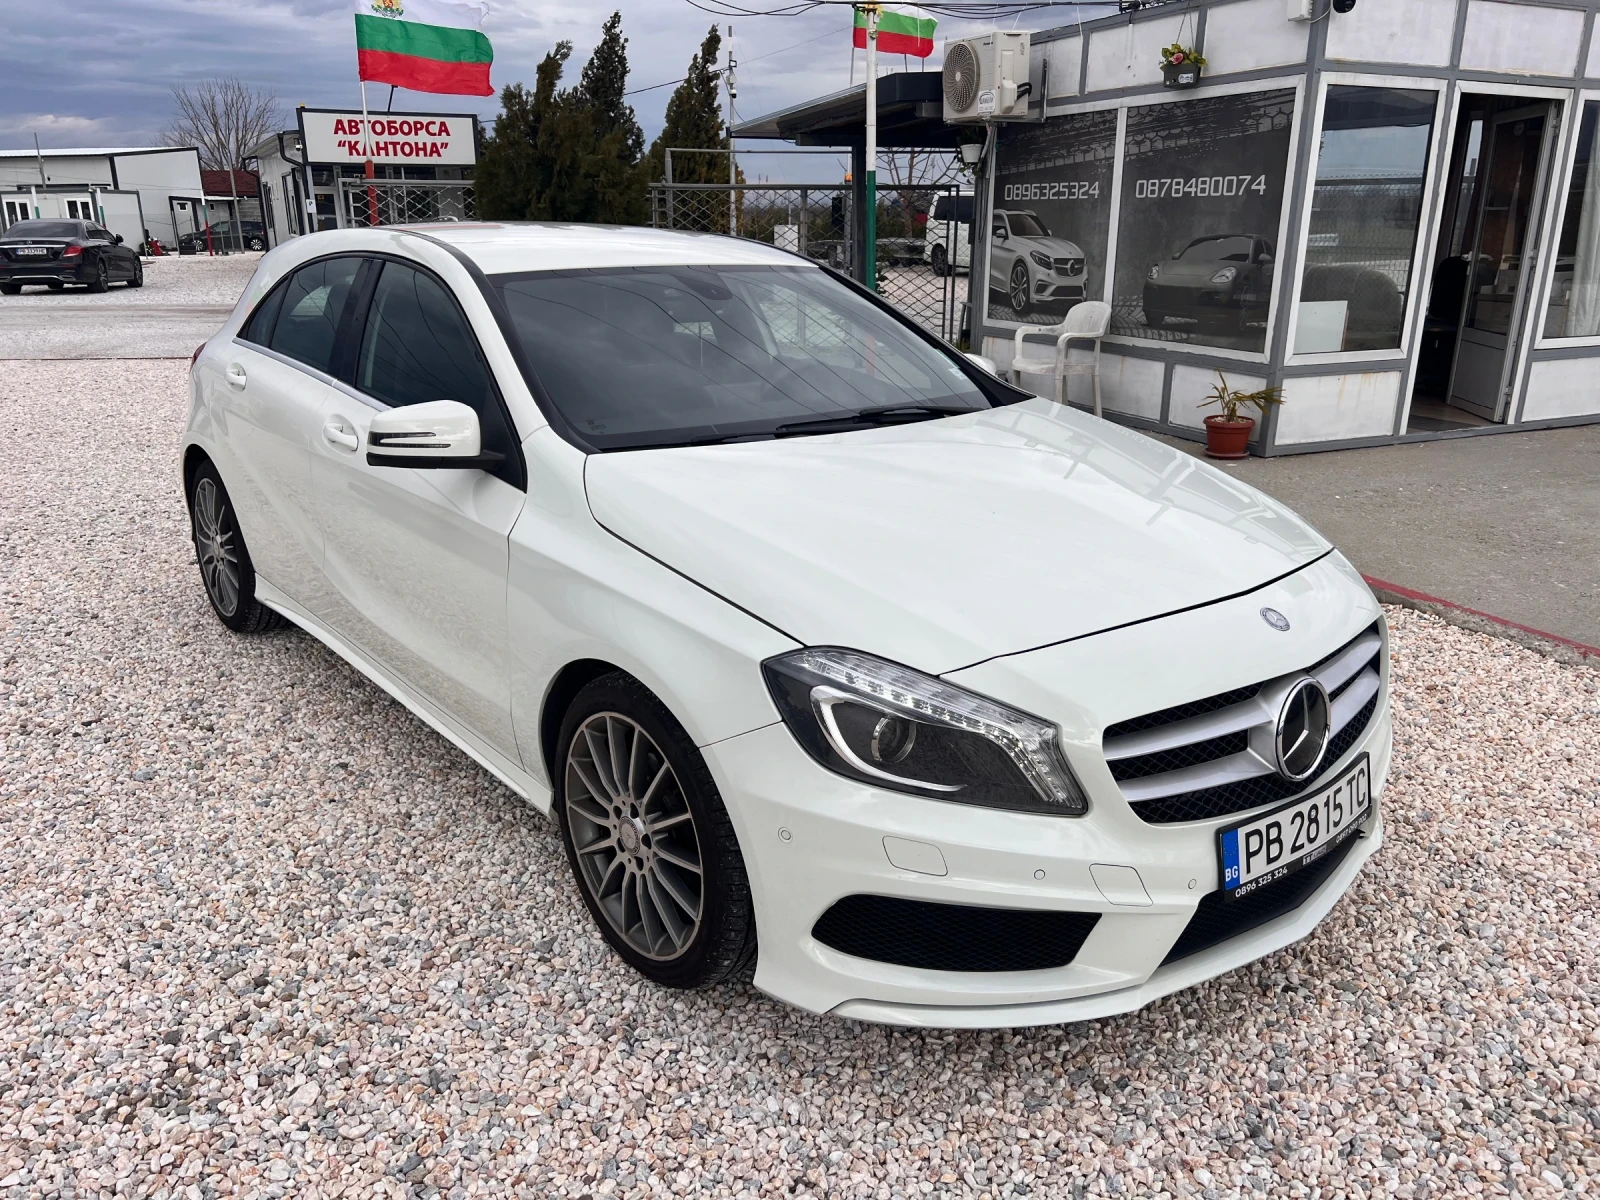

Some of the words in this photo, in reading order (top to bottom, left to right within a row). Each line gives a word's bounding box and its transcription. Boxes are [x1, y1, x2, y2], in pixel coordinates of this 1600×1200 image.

[1004, 181, 1099, 200] 0896325324
[1136, 175, 1266, 198] 0878480074
[1245, 821, 1283, 875] PB
[1290, 786, 1343, 855] 2815
[1346, 767, 1366, 816] TC
[1225, 866, 1239, 882] BG
[1235, 882, 1257, 898] 0896
[1258, 875, 1272, 887] 325
[1273, 865, 1288, 879] 324
